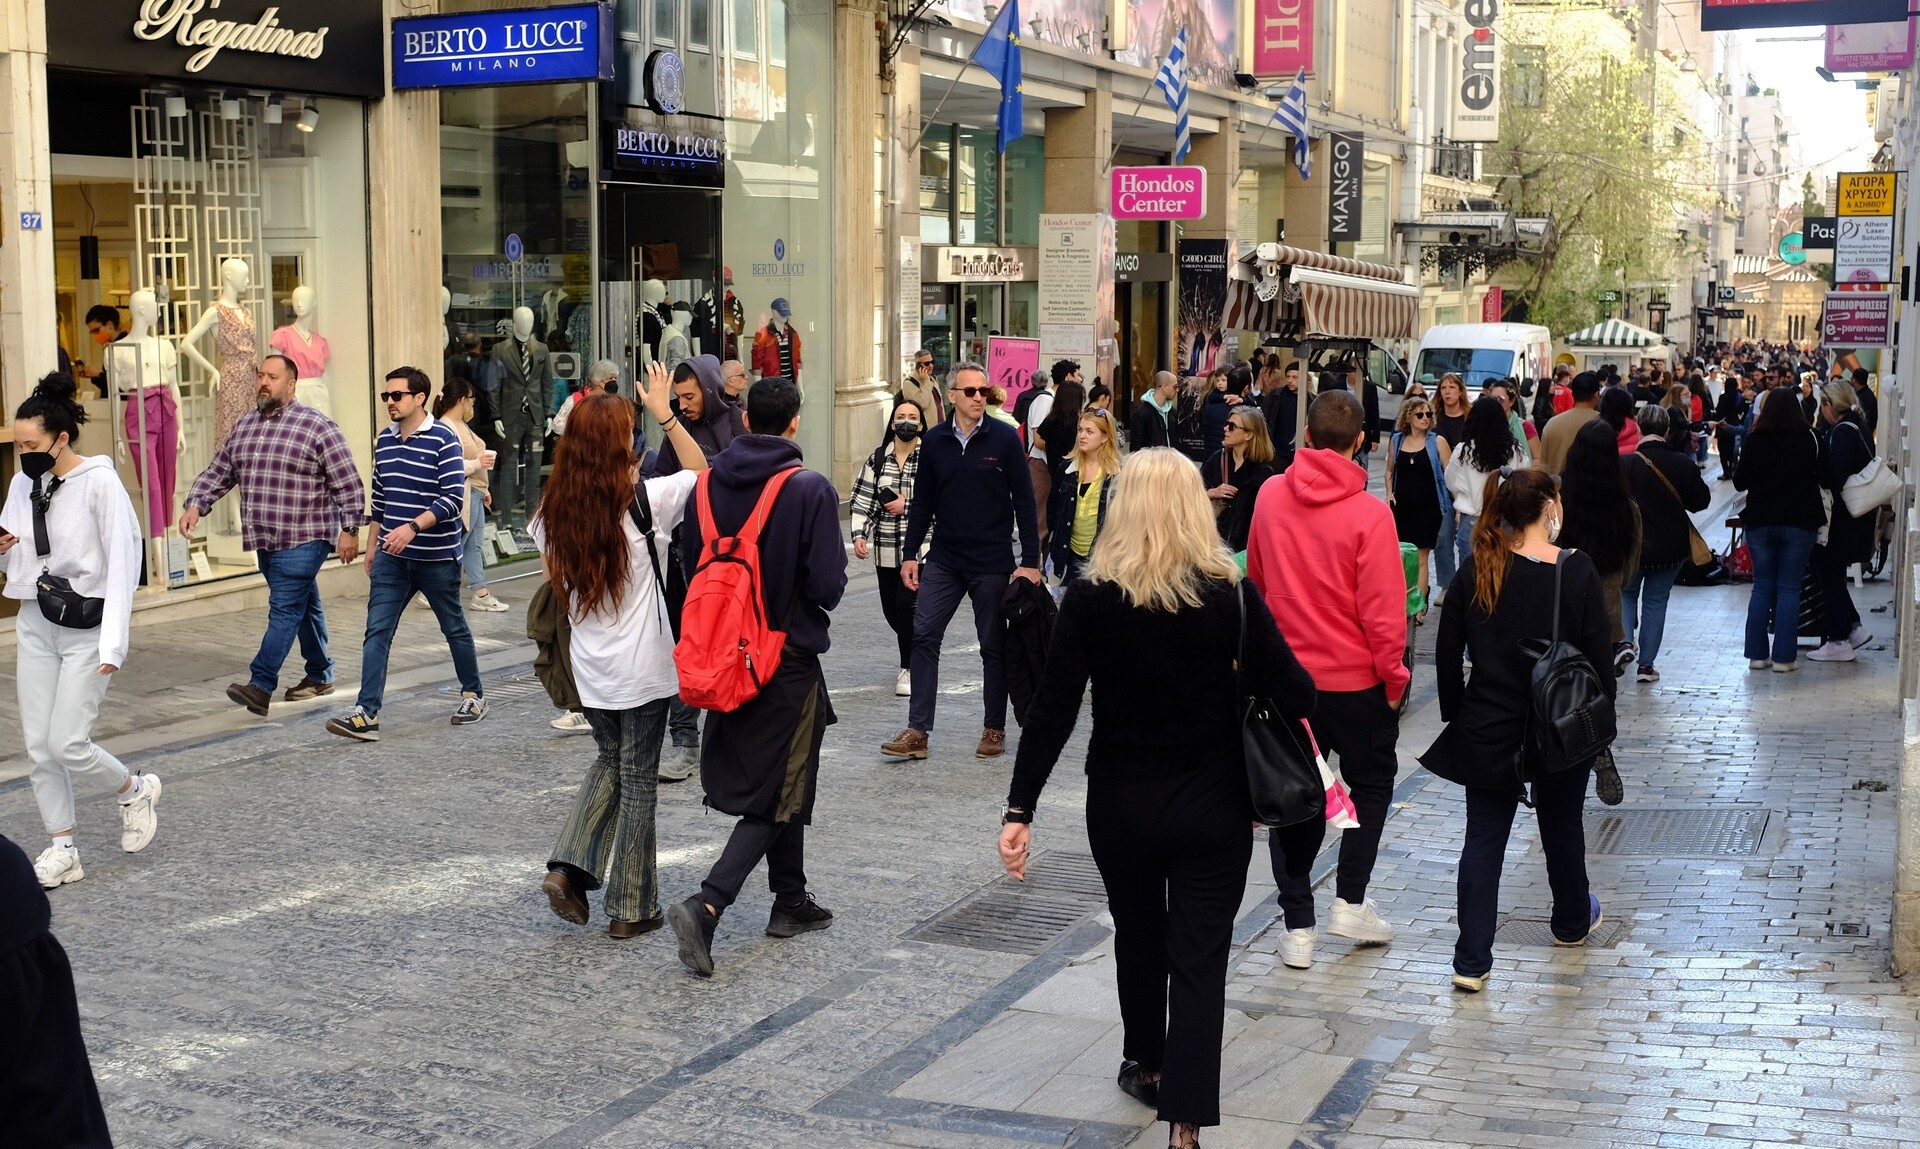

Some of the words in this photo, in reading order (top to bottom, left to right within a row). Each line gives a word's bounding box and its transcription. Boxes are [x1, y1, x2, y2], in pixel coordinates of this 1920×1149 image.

[133, 0, 330, 73] Regalinas
[404, 27, 487, 56] BERTO
[451, 57, 536, 72] MILANO
[617, 128, 669, 154] BERTO
[676, 135, 719, 158] LUCCI
[641, 158, 696, 168] MILANO
[1119, 174, 1195, 193] Hondos
[1332, 140, 1350, 233] MANGO
[1849, 176, 1885, 187] ΑΓΟΡΑ
[1845, 189, 1889, 200] ΧΡΥΣΟΥ
[1119, 192, 1187, 213] Center
[22, 213, 40, 228] 37
[1044, 218, 1068, 226] Hondos
[1070, 218, 1092, 226] Center
[1115, 256, 1139, 271] ANGO
[1182, 254, 1203, 263] GOOD
[1204, 254, 1226, 263] GIRL
[752, 263, 778, 275] BERTO
[782, 263, 805, 275] LUCCI
[1718, 287, 1734, 298] 10
[1827, 300, 1888, 310] ΕΠΙΔΙΟΡΘΩΣΕΙΣ
[1855, 311, 1887, 320] ρούχων
[1826, 323, 1886, 336] e-paramana
